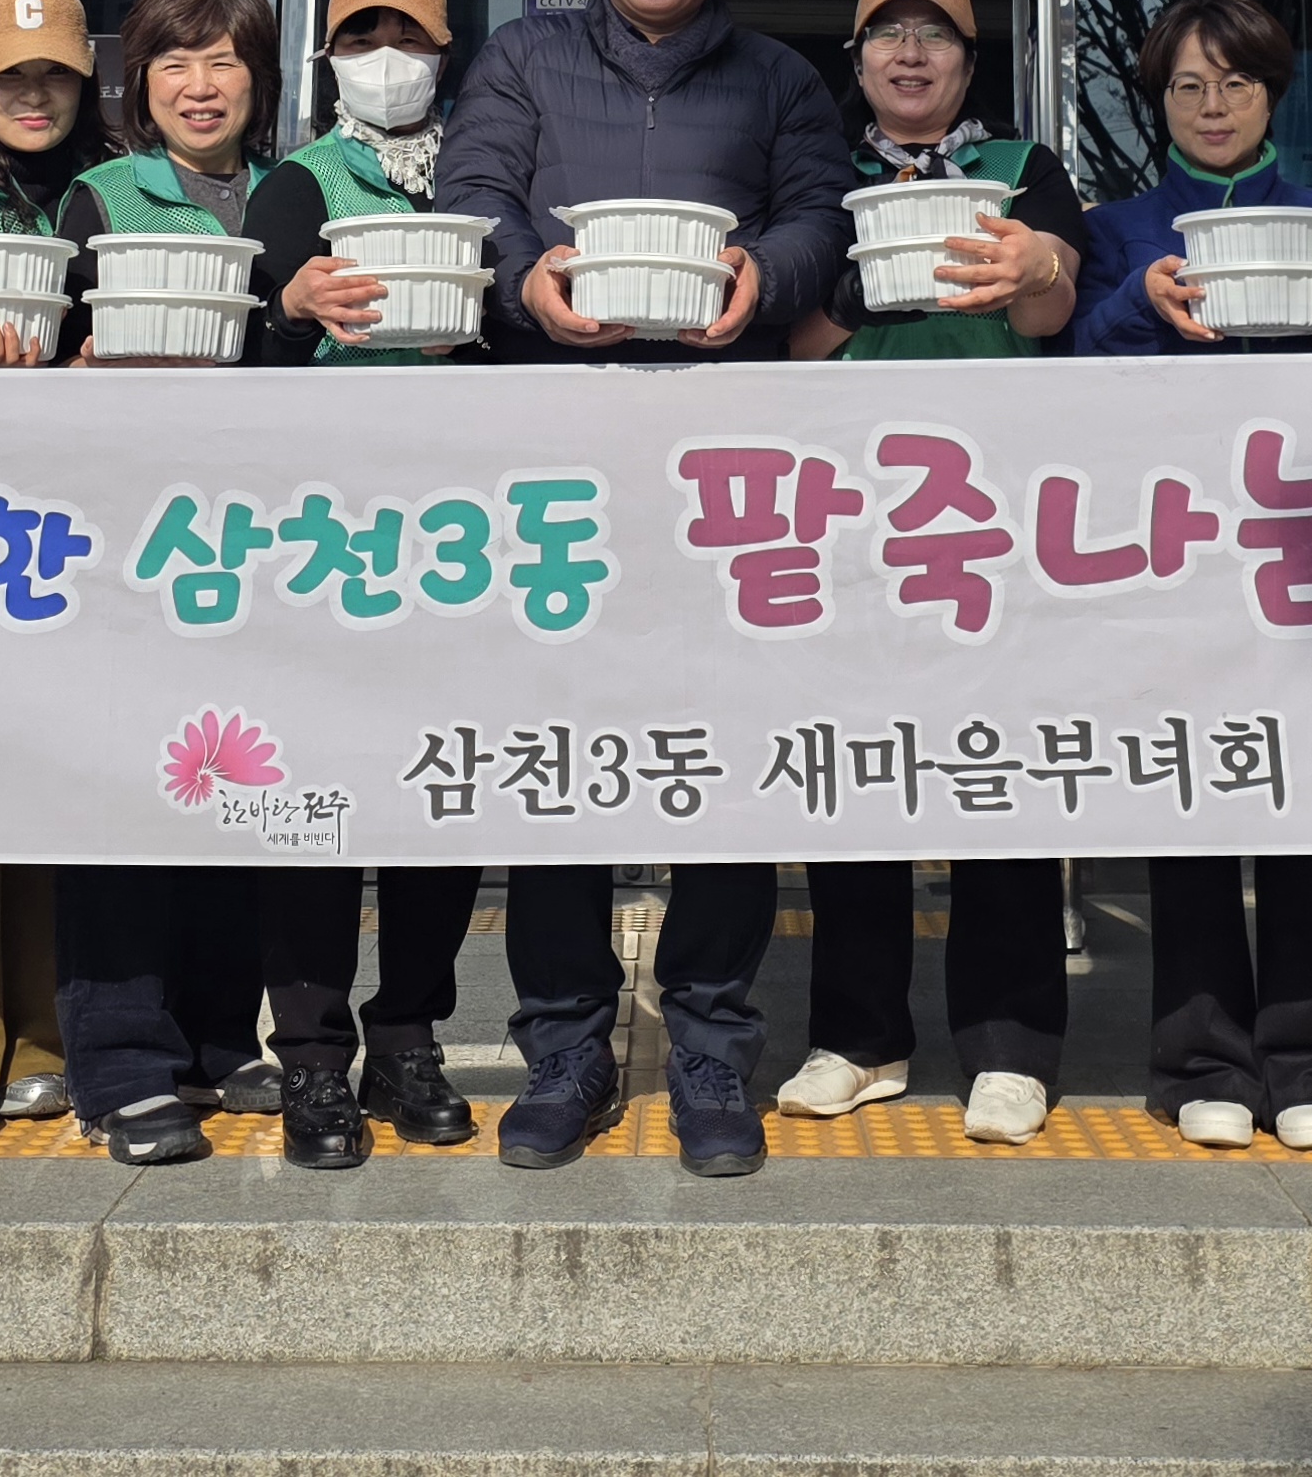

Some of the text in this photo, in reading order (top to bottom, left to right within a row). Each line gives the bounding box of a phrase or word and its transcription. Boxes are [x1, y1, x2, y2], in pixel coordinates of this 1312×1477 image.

[136, 479, 609, 631] 삼천3동
[403, 716, 1287, 821] 삼천3동 새마을부녀회
[267, 832, 336, 847] 세계를 비빈다
